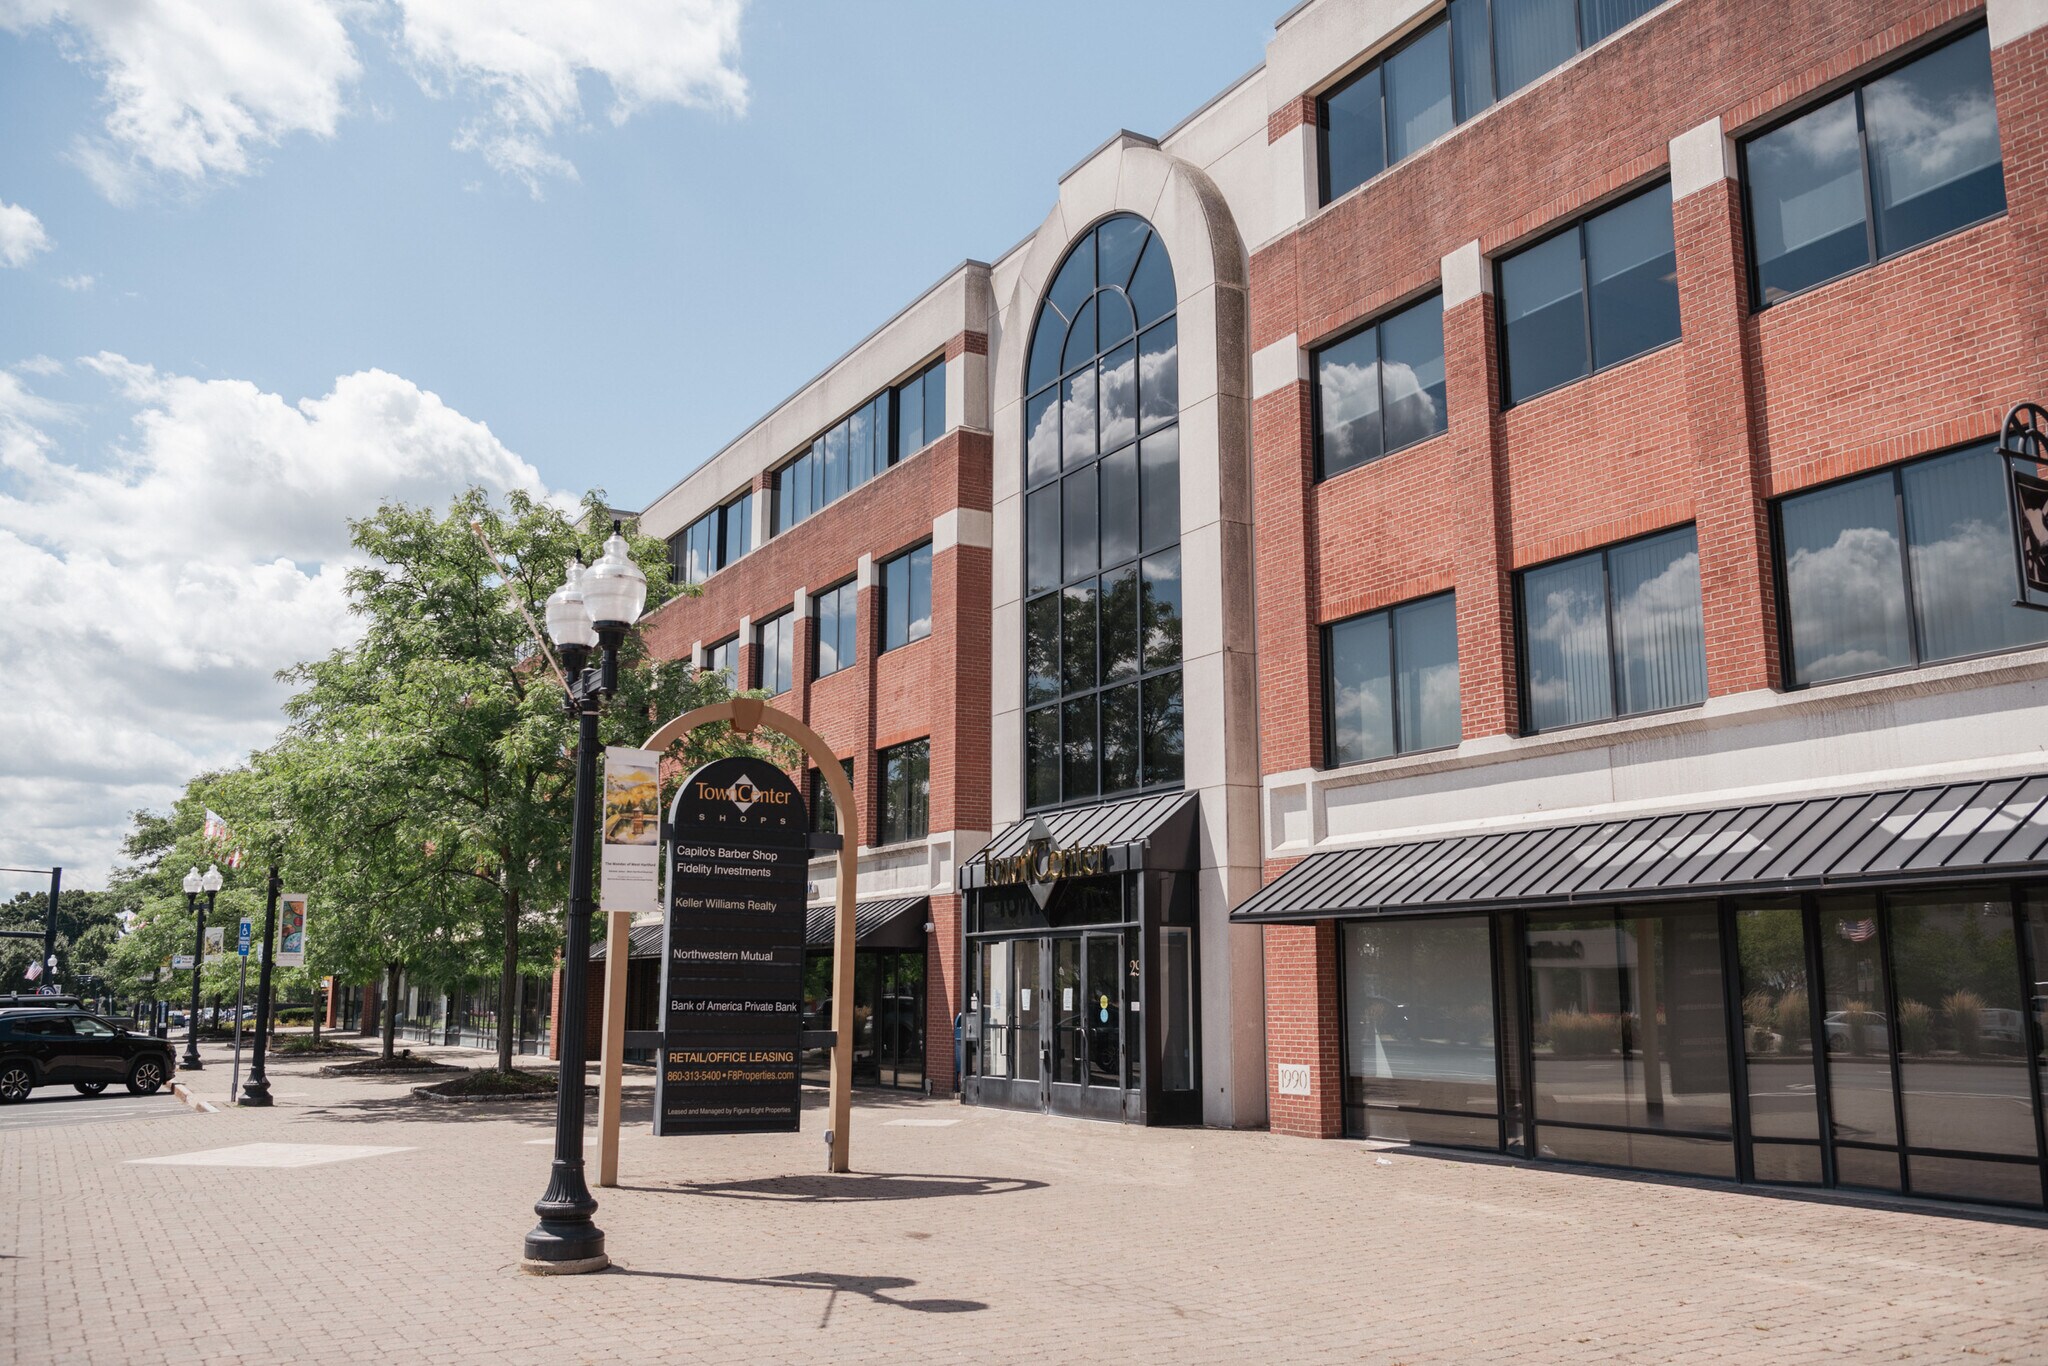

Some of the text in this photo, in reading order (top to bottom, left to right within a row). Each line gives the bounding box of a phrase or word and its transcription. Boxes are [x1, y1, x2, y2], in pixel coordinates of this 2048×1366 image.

[699, 814, 786, 824] SHOPS
[677, 846, 778, 862] Capilo's Barber Shop
[677, 863, 771, 877] Fidelity Investments
[675, 898, 777, 912] Keller Williams Realty
[674, 949, 773, 961] Northwestern Mutual
[672, 1001, 797, 1012] Bank of America Private Bank
[669, 1052, 793, 1063] RETAIL/OFFICE LEASING
[668, 1070, 794, 1082] 860-313-5400 F8Properties.com
[1281, 1069, 1308, 1089] 1990
[700, 1108, 724, 1116] Managed
[733, 1107, 750, 1115] Figure
[751, 1107, 764, 1115] Eight
